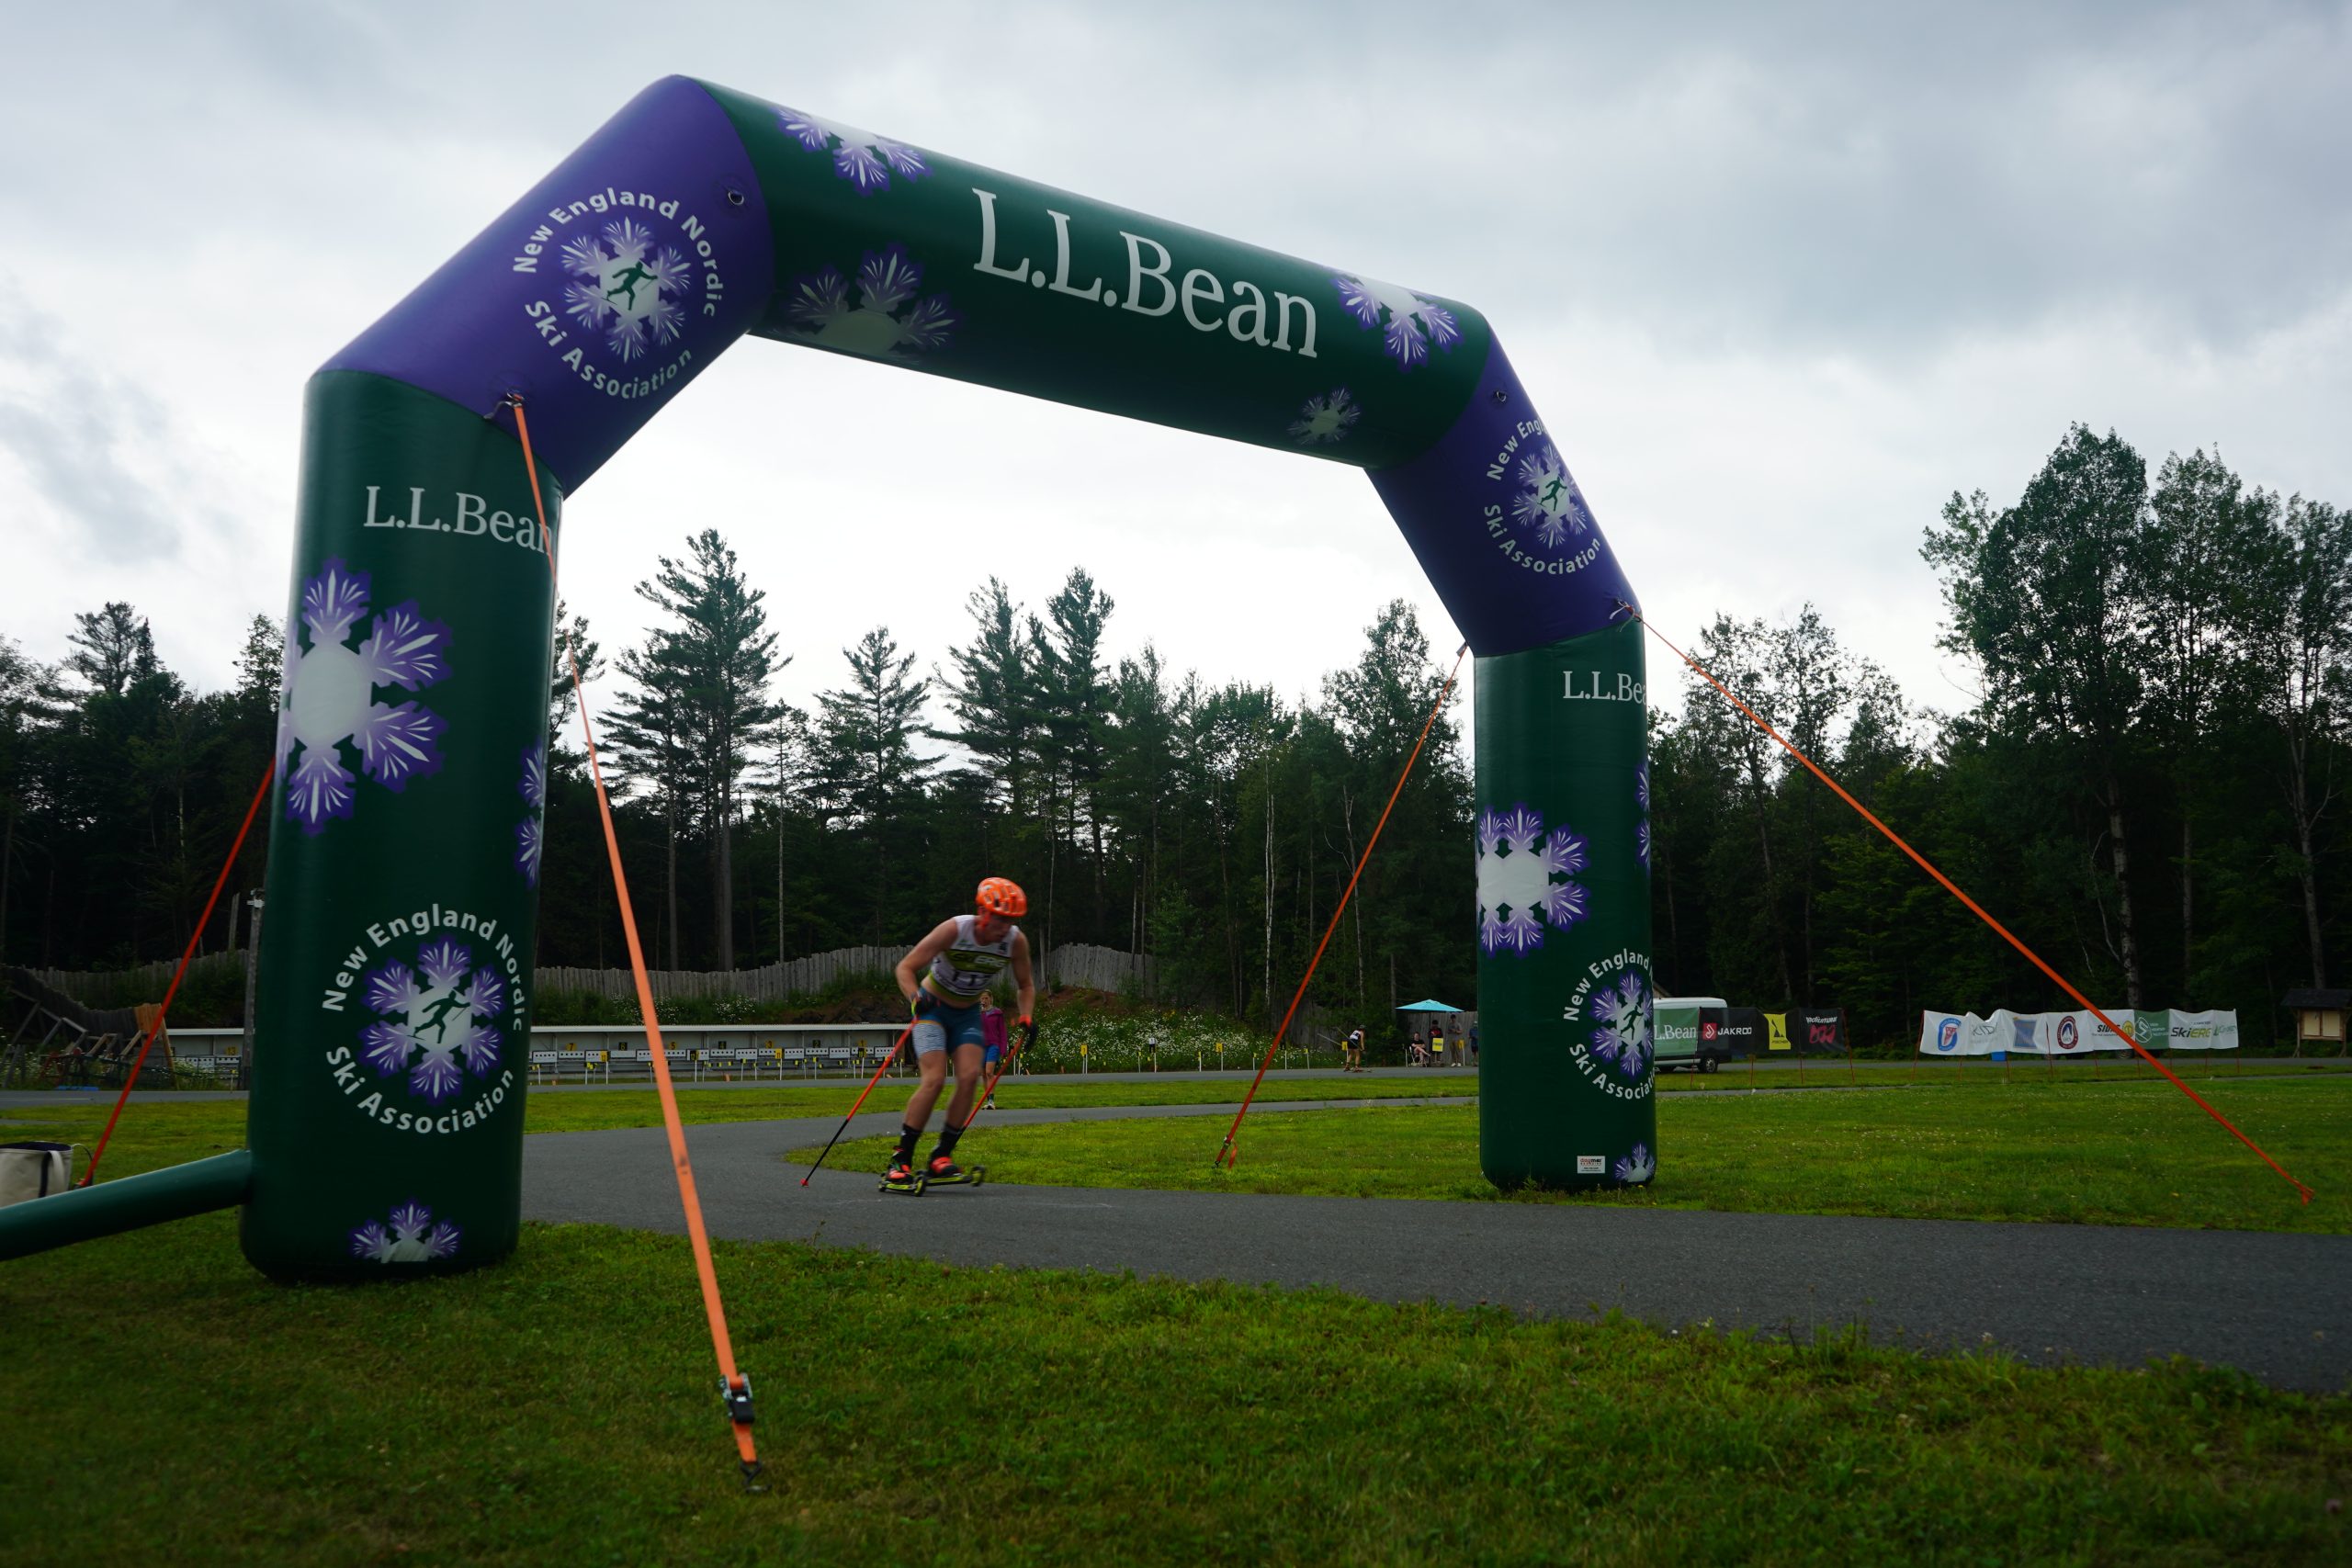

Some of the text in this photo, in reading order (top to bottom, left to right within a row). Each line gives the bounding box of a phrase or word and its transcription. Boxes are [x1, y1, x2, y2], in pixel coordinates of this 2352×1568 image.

[513, 186, 724, 317] New England Nordic
[971, 186, 1317, 358] L.L.Bean
[525, 299, 692, 400] Ski Association
[1487, 417, 1548, 480] New Engl
[363, 485, 552, 557] L.L.Bean
[1484, 504, 1600, 575] Ski Association
[322, 903, 526, 1031] New England Nordic
[1563, 976, 1591, 1021] New
[1588, 948, 1650, 980] England
[1717, 1026, 1753, 1036] JAKROO
[325, 1046, 514, 1134] Ski Association
[1569, 1043, 1654, 1100] Ski Associati
